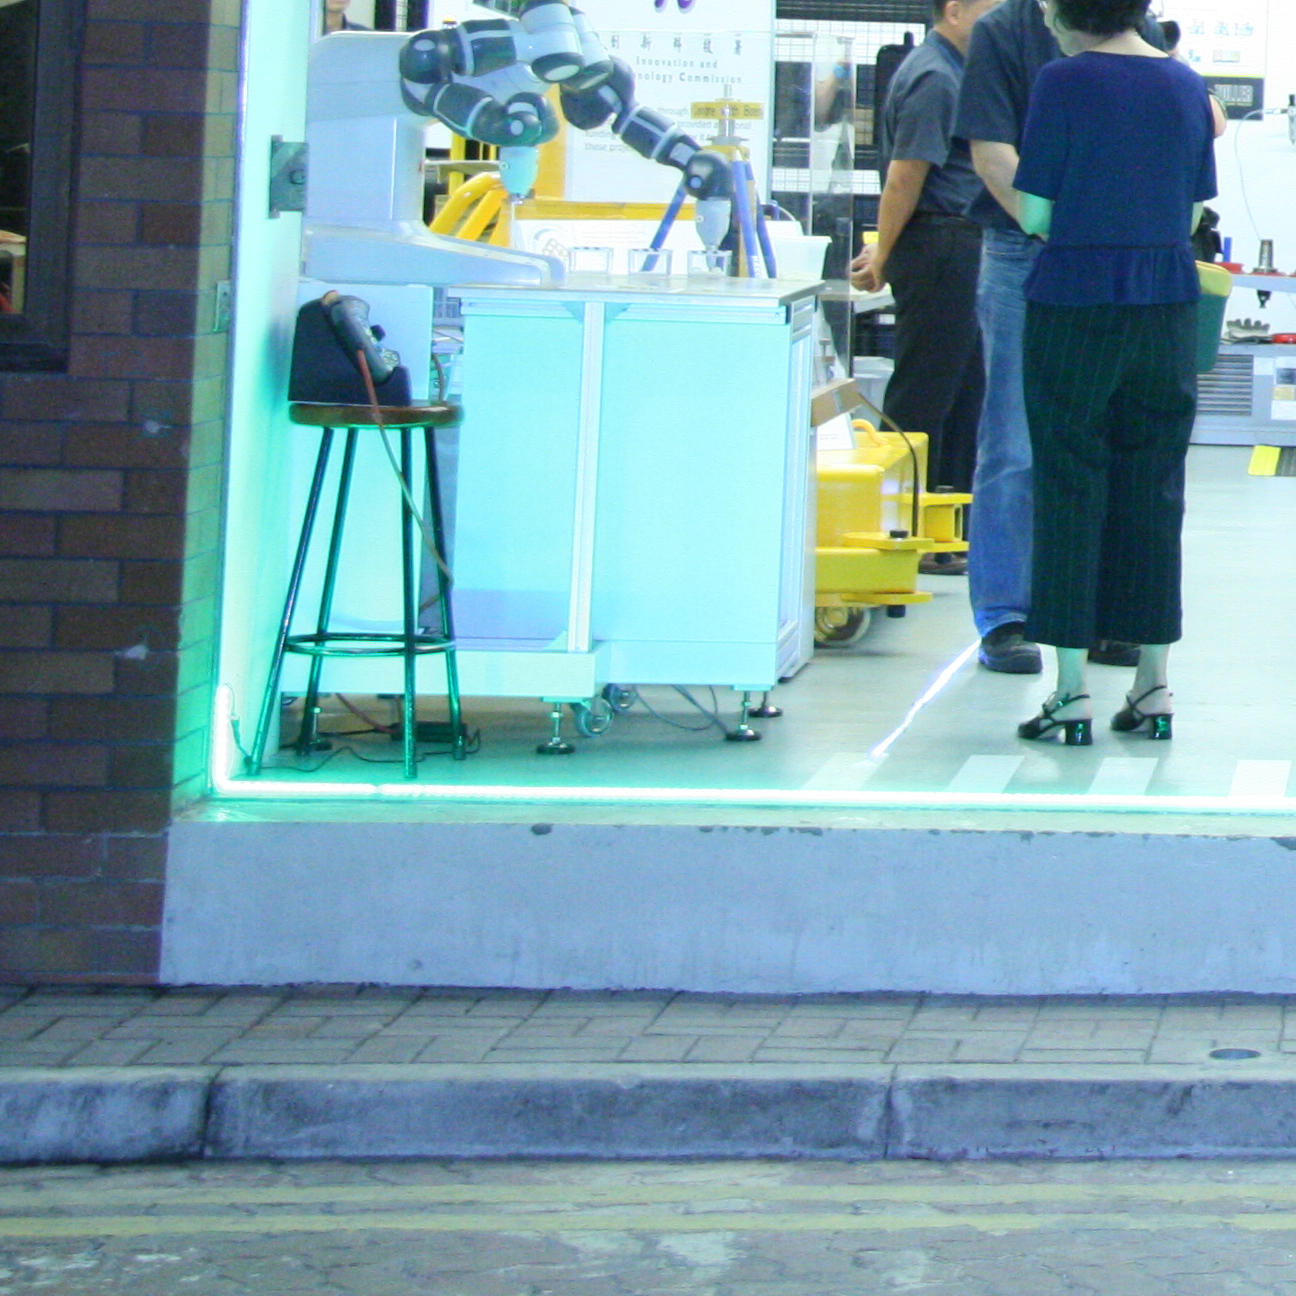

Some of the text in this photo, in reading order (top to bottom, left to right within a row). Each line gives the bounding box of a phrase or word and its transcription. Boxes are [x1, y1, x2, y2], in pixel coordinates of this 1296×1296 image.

[636, 55, 718, 69] Innovation and
[679, 71, 742, 84] Commission
